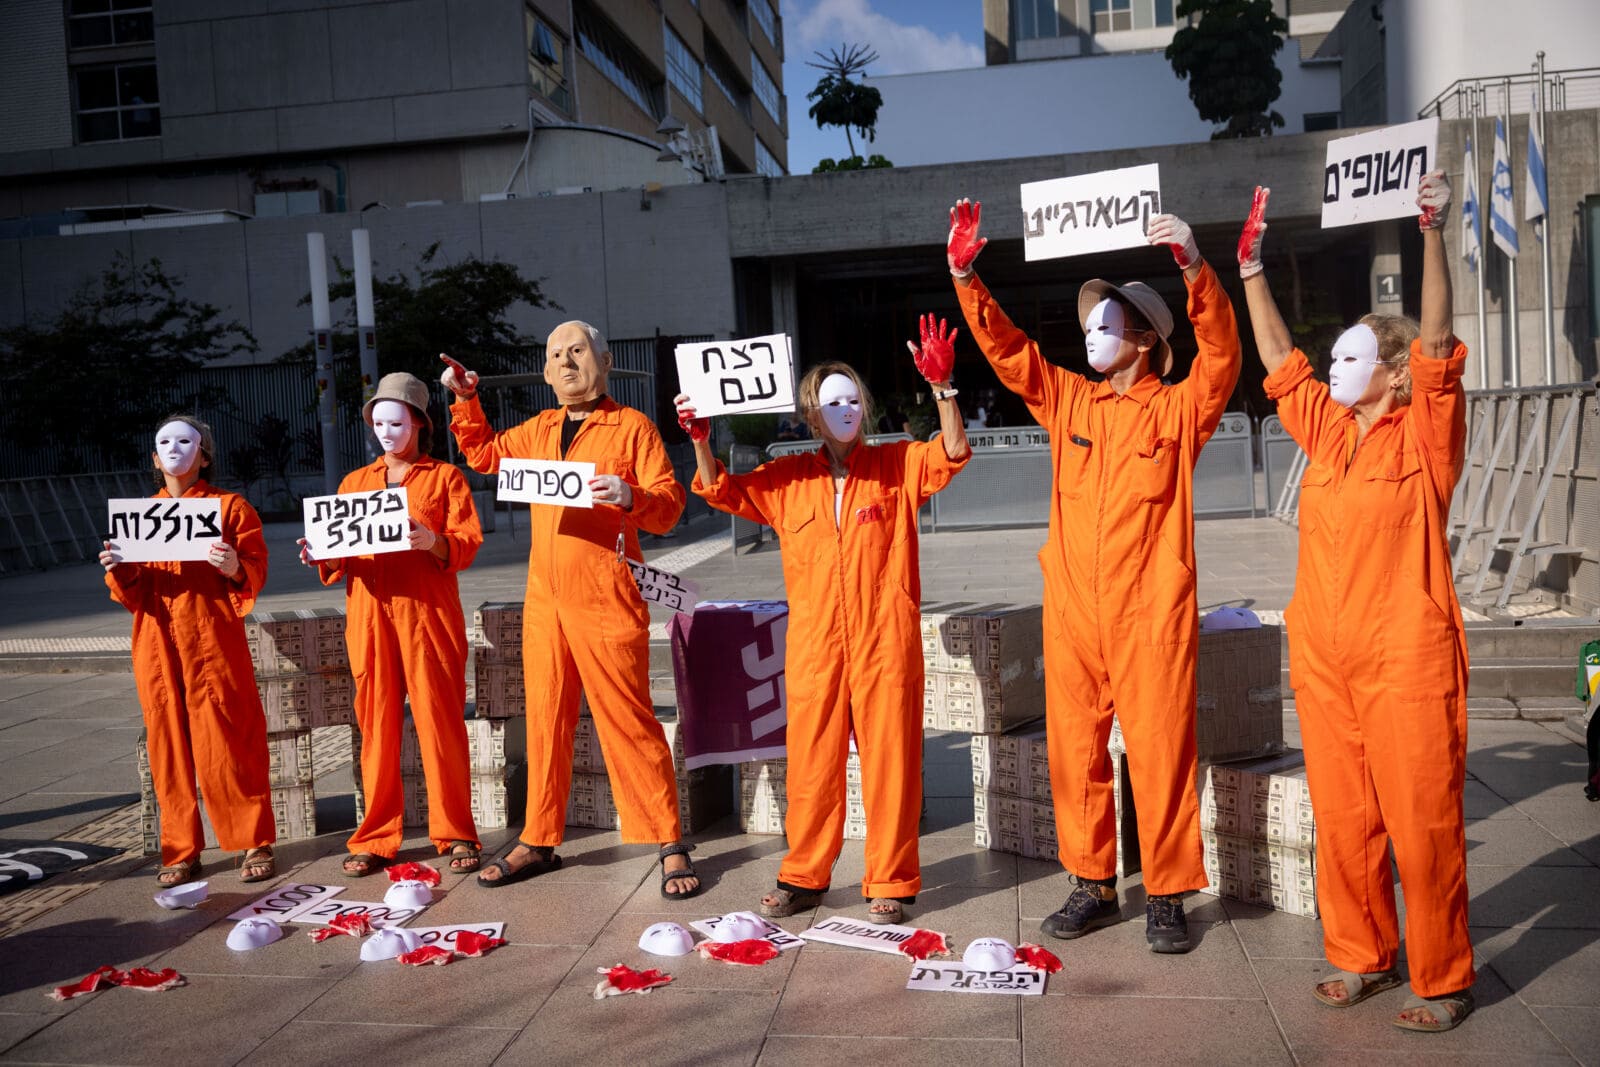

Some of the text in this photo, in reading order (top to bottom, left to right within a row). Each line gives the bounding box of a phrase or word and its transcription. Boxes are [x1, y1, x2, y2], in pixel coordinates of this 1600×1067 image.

[1323, 145, 1428, 203] חטופים
[1023, 189, 1160, 241] קטארגייט
[1381, 276, 1394, 294] 1
[702, 341, 775, 373] רצח
[719, 372, 778, 405] עם
[968, 433, 1050, 447] שמר בתי המש
[498, 468, 583, 500] ספרטה
[108, 502, 222, 543] צוללות
[312, 490, 405, 523] מלחמת
[326, 516, 403, 549] שולל
[252, 883, 327, 915] 1000
[910, 967, 1040, 987] הפקרת
